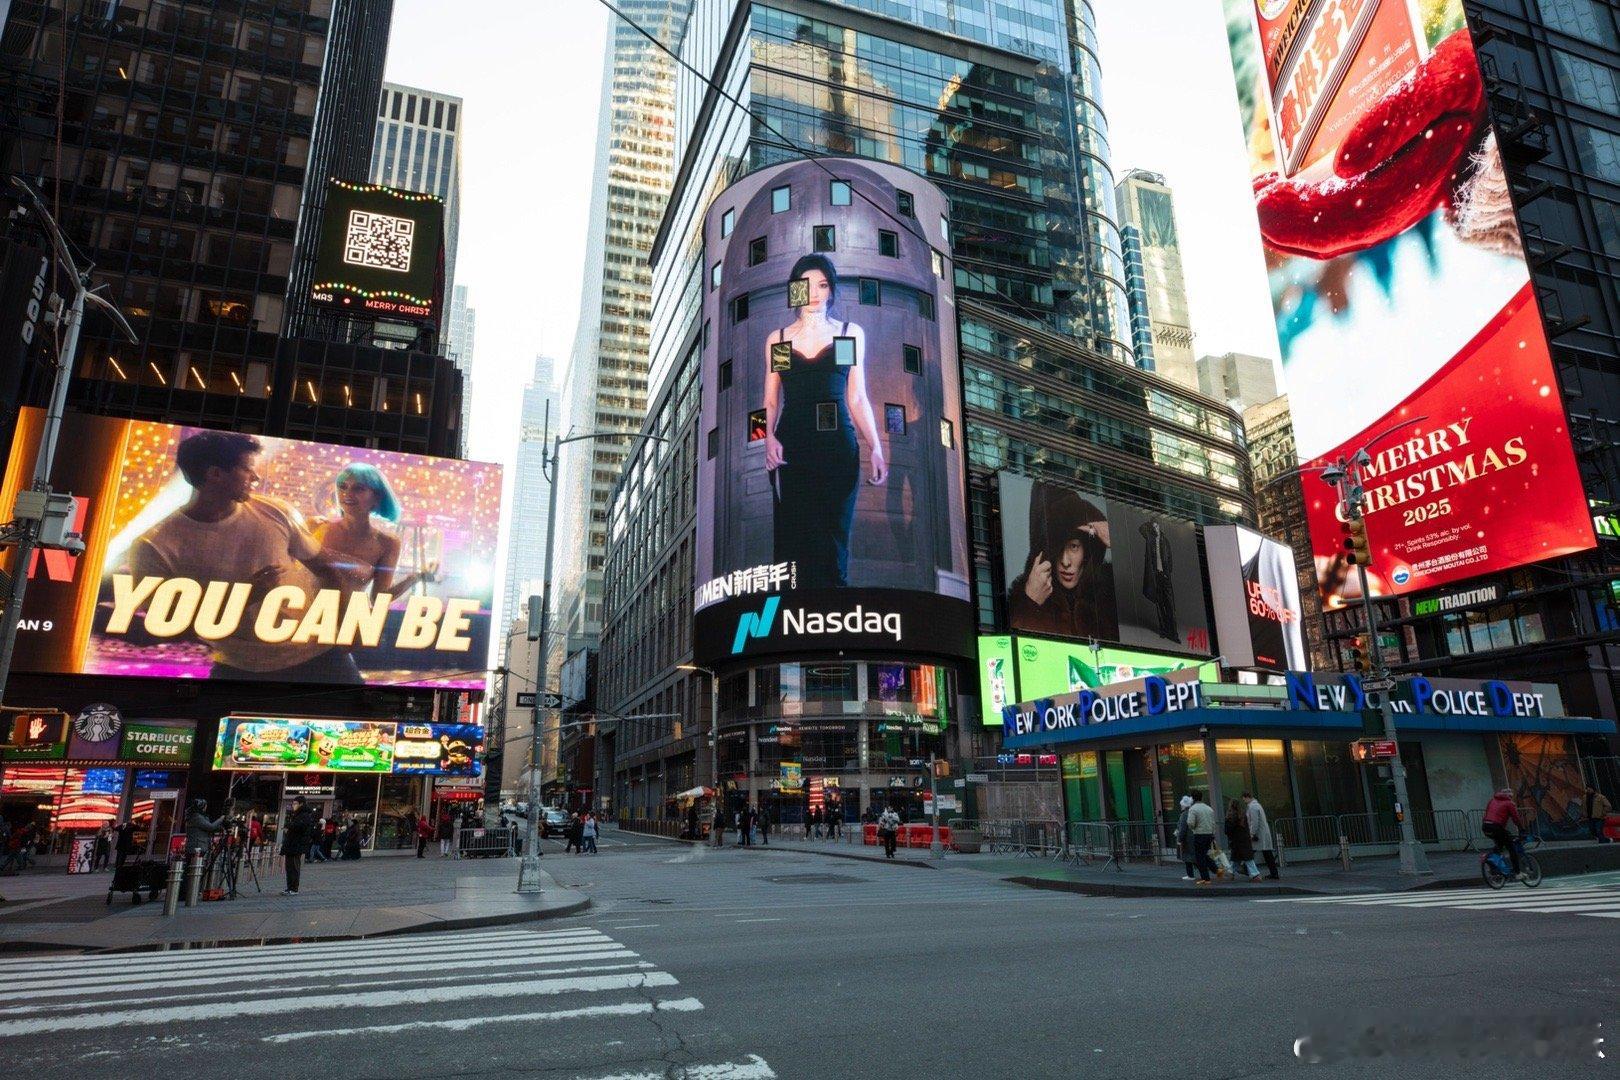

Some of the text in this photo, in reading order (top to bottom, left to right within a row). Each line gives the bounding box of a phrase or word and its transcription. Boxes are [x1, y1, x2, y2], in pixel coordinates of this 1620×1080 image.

[313, 292, 333, 302] MAS
[365, 300, 430, 316] MERRY CHRIST
[1362, 417, 1472, 482] MERRY
[1334, 435, 1528, 524] CHRISTMAS
[1402, 498, 1452, 527] 2025
[1451, 526, 1461, 537] by
[1406, 544, 1422, 553] Drink
[1442, 559, 1466, 572] MOUTAI
[106, 574, 480, 652] YOU CAN BE
[1250, 598, 1276, 620] 60%
[16, 619, 53, 631] AN 9
[783, 605, 901, 641] Nasdaq
[1286, 671, 1543, 717] NEW YOK POLICE DEPT
[1002, 676, 1199, 737] NEW YORK POLICE DEPT
[127, 731, 192, 744] STARBUCKS
[136, 744, 178, 755] COFFEE
[68, 840, 80, 874] CHICAGO
